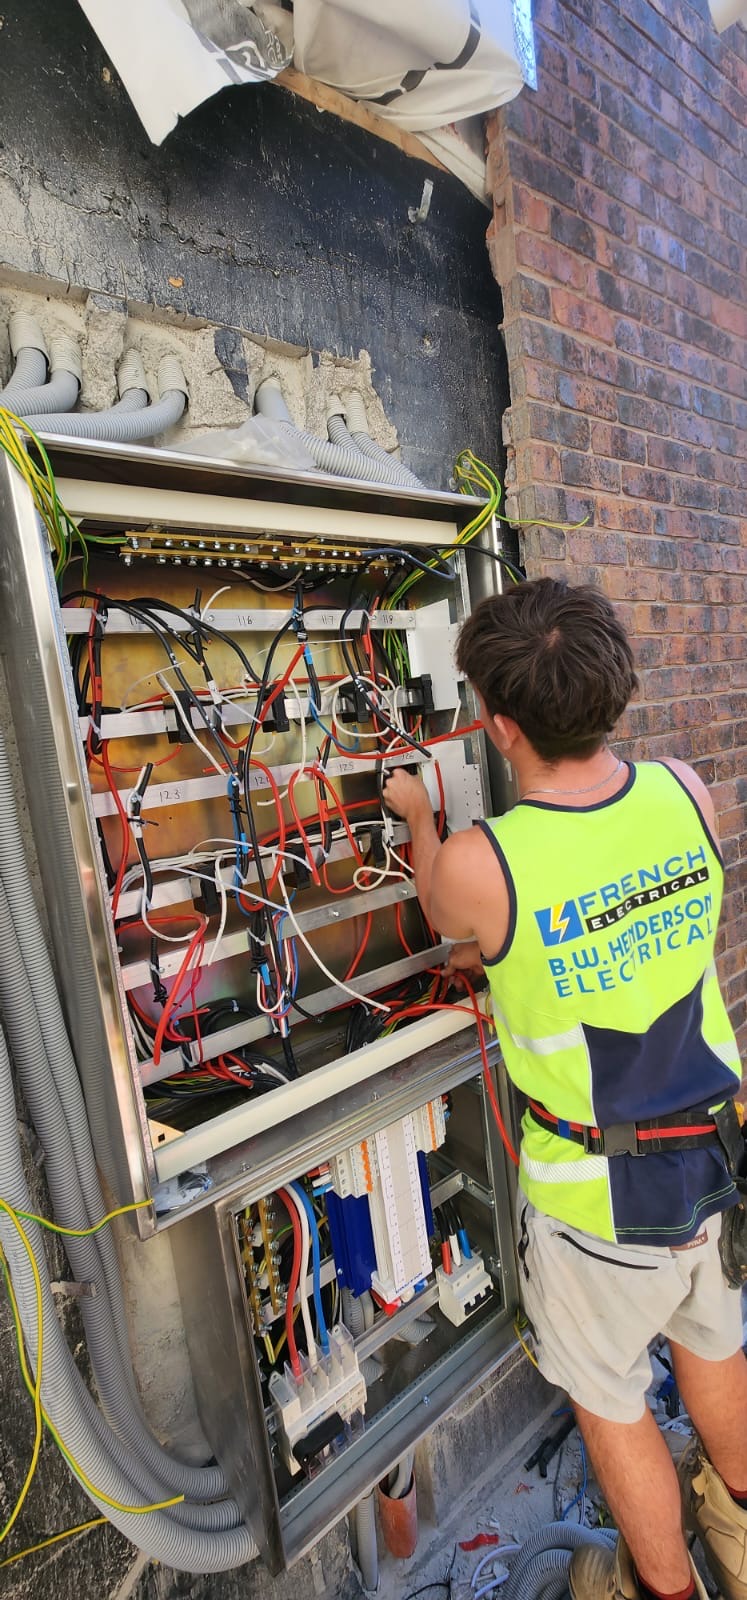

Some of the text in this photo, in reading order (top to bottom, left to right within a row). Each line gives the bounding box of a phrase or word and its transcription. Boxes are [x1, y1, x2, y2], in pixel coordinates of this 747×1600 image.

[237, 615, 253, 627] 116
[322, 615, 334, 625] 117
[160, 789, 180, 803] 123
[578, 845, 707, 916] FRENCH
[590, 872, 707, 930] ELECTRICAL
